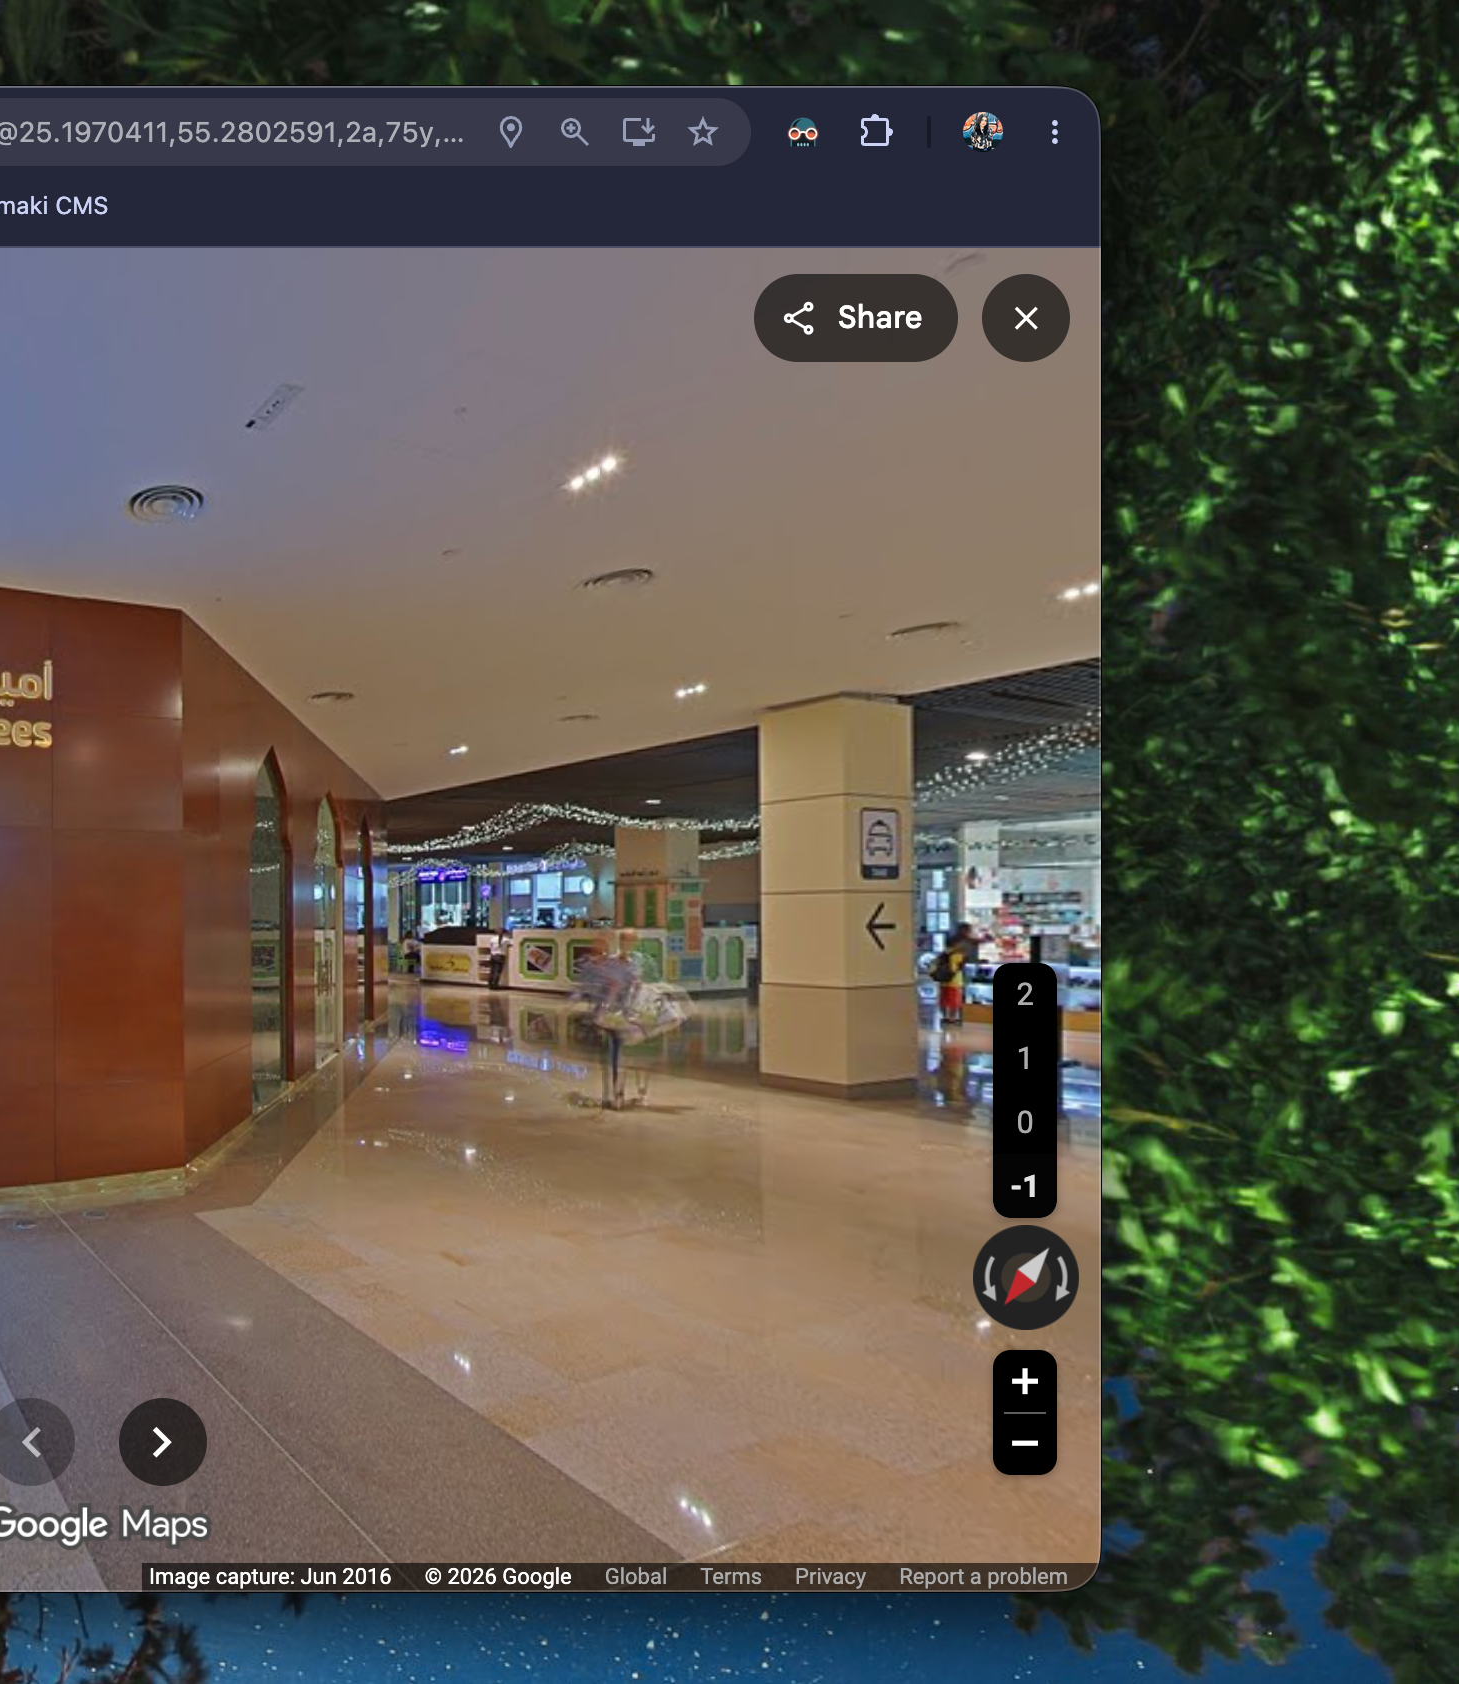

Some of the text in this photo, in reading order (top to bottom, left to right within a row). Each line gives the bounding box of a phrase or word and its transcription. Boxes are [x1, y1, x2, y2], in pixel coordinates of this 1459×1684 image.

[55, 195, 109, 216] CMS
[838, 302, 923, 330] Share
[1017, 981, 1034, 1006] 2
[1018, 1046, 1029, 1070] 1
[1017, 1109, 1033, 1134] 0
[1010, 1173, 1036, 1198] -1
